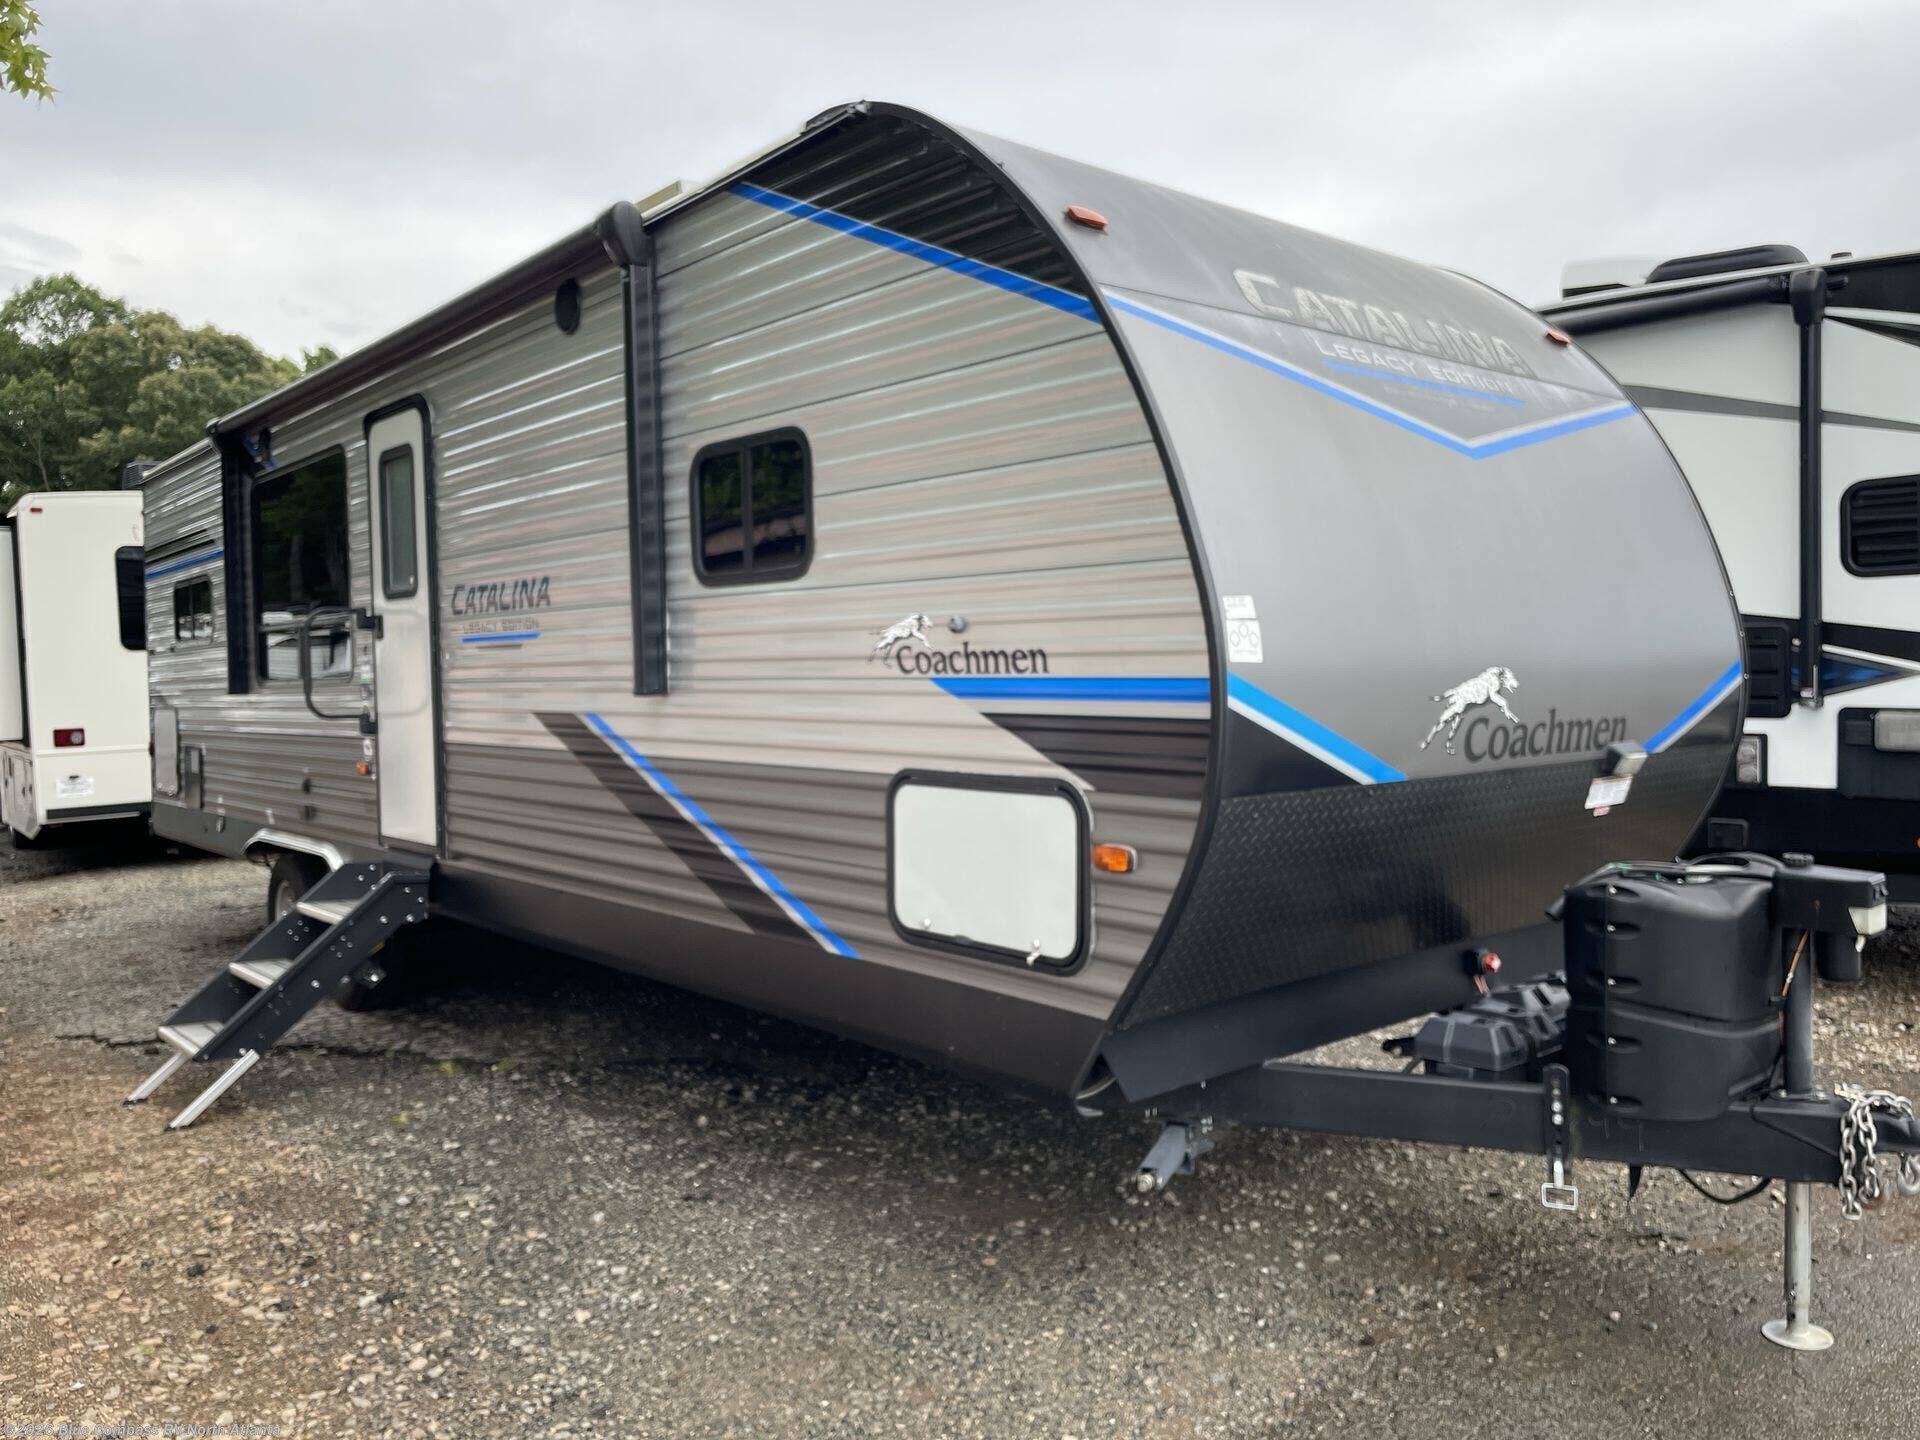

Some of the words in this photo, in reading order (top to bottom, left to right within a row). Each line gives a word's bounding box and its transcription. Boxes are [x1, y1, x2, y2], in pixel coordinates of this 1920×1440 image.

[1233, 269, 1538, 379] CATALINA
[1304, 329, 1418, 377] LEGACY
[1424, 363, 1514, 395] EDITION
[451, 576, 551, 615] CATALINA
[896, 641, 1050, 675] Coachmen
[1464, 708, 1627, 763] Coachmen
